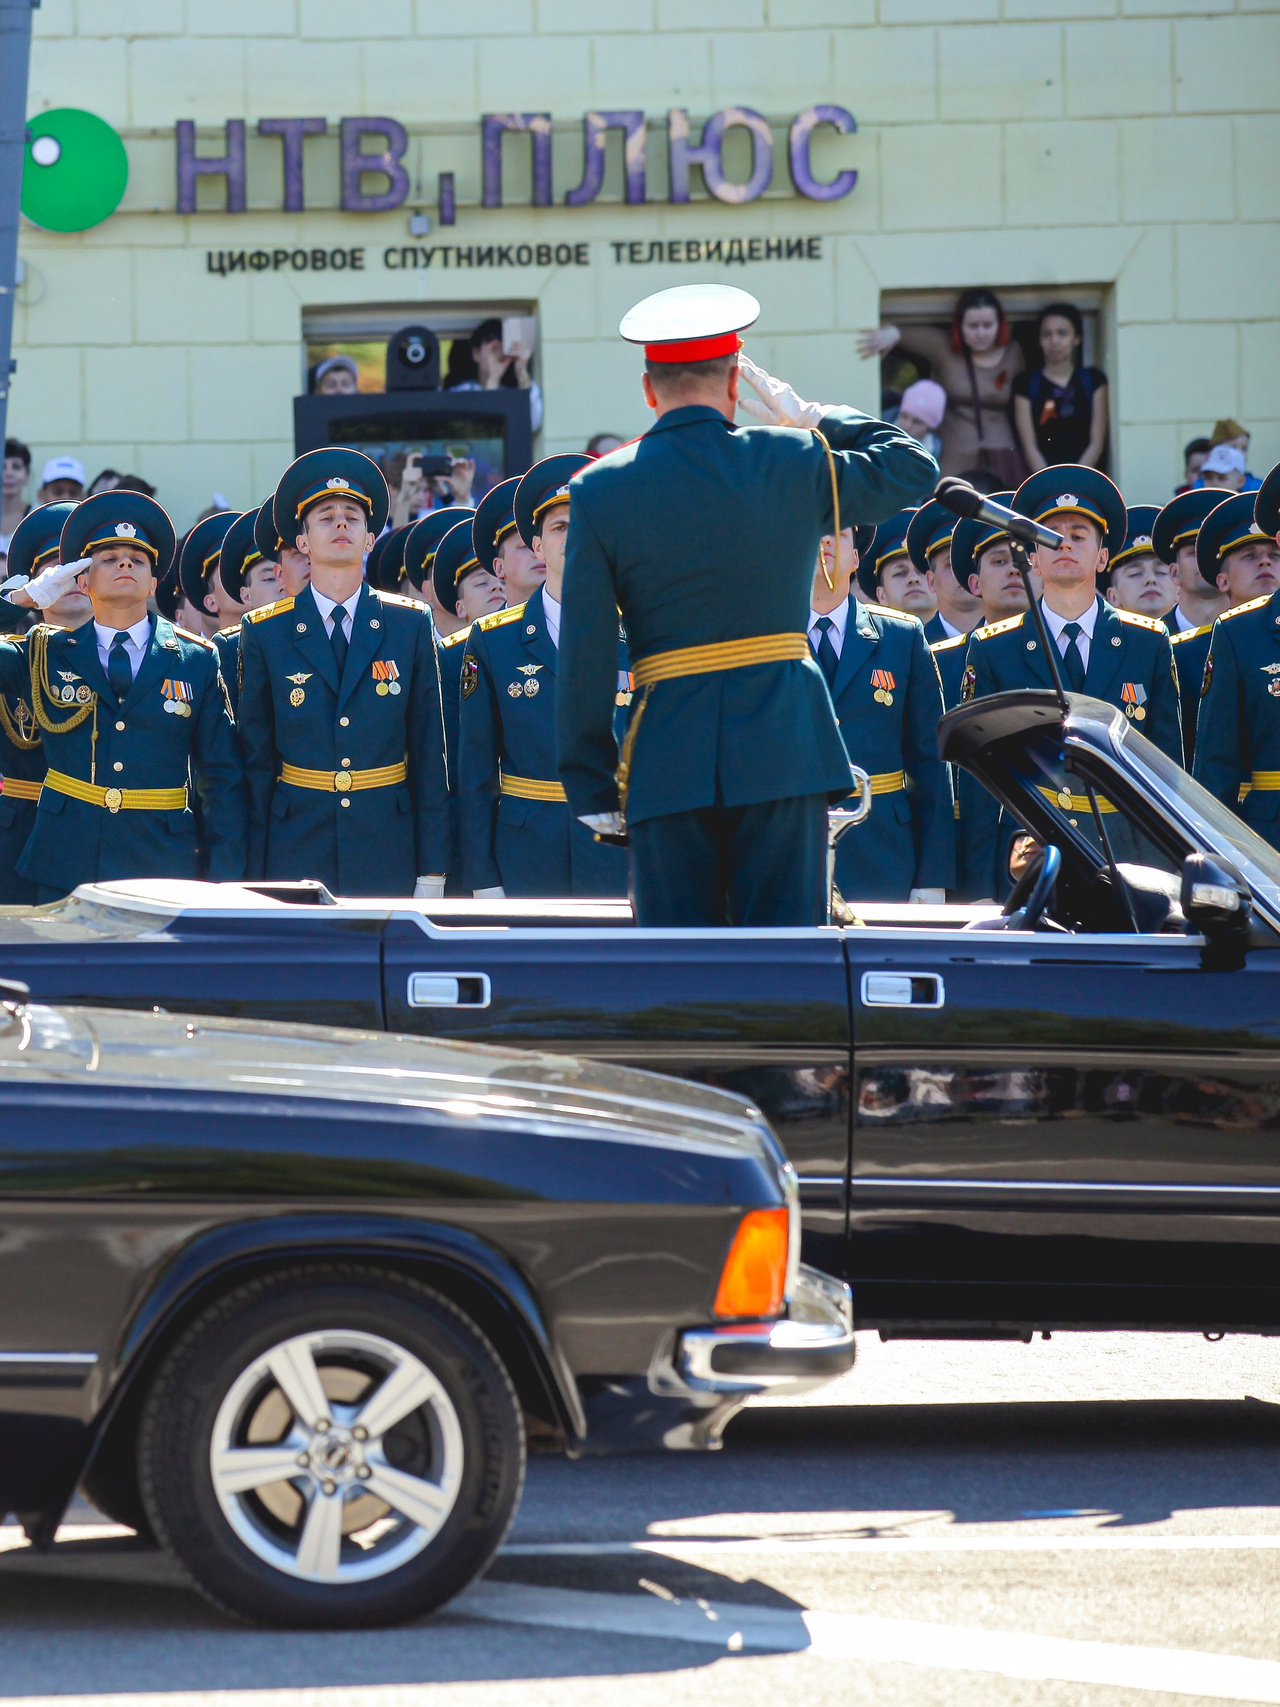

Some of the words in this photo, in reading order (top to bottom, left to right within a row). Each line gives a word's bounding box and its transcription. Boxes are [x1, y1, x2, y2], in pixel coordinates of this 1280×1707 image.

[481, 104, 859, 208] ПЛЮС
[207, 248, 365, 276] ЦИФРОВОЕ
[384, 243, 589, 270] СПУТНИКОВОЕ
[610, 237, 822, 266] ТЕЛЕВИДЕНИЕ
